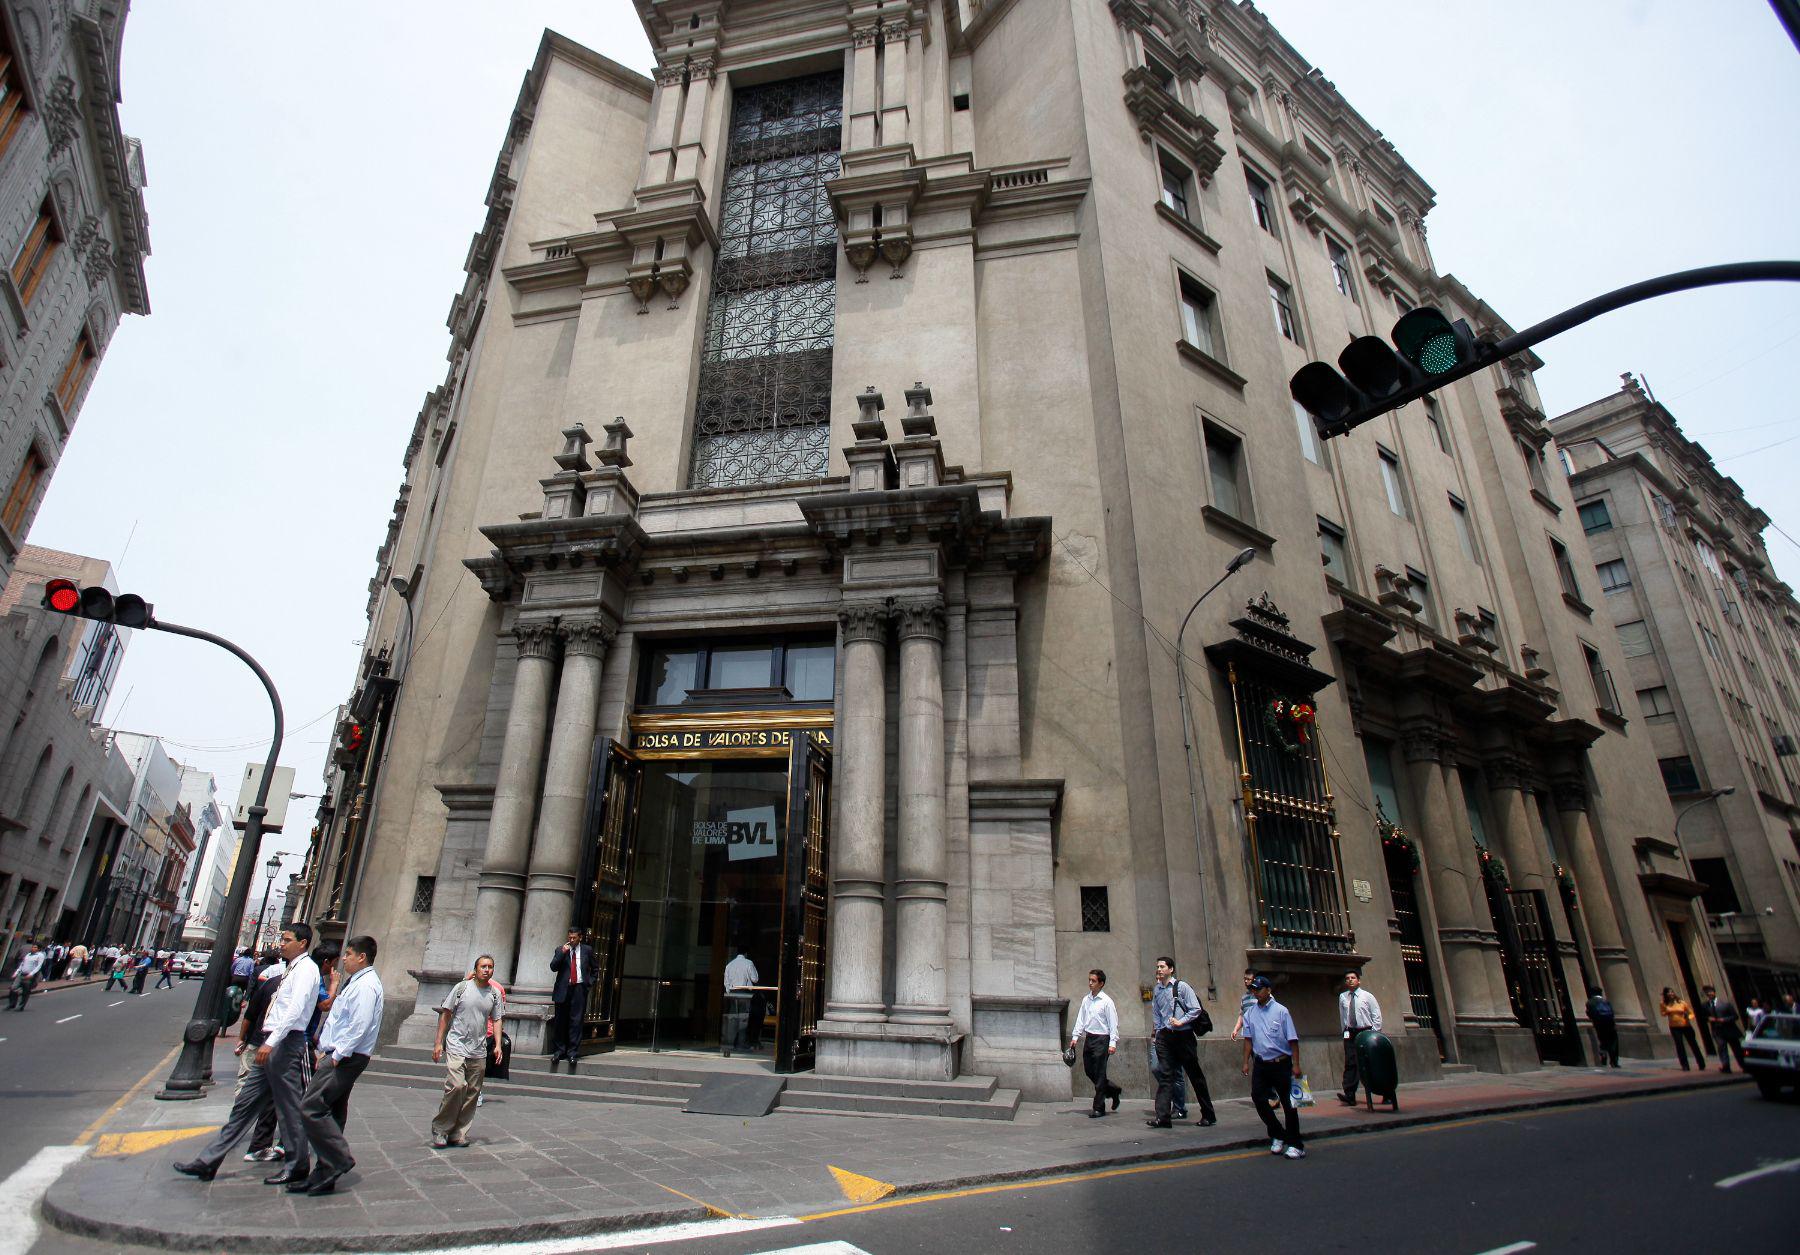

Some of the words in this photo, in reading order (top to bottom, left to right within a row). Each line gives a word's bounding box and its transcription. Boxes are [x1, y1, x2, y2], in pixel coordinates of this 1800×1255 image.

[638, 734, 679, 747] BOLSA
[683, 733, 702, 746] DE
[709, 732, 767, 746] VALORES
[771, 731, 789, 745] DE
[694, 821, 716, 829] BOLSA
[717, 821, 728, 829] DE
[693, 828, 728, 837] VALORES
[727, 822, 773, 844] BVL
[692, 836, 704, 845] DE
[704, 836, 726, 845] LIMA
